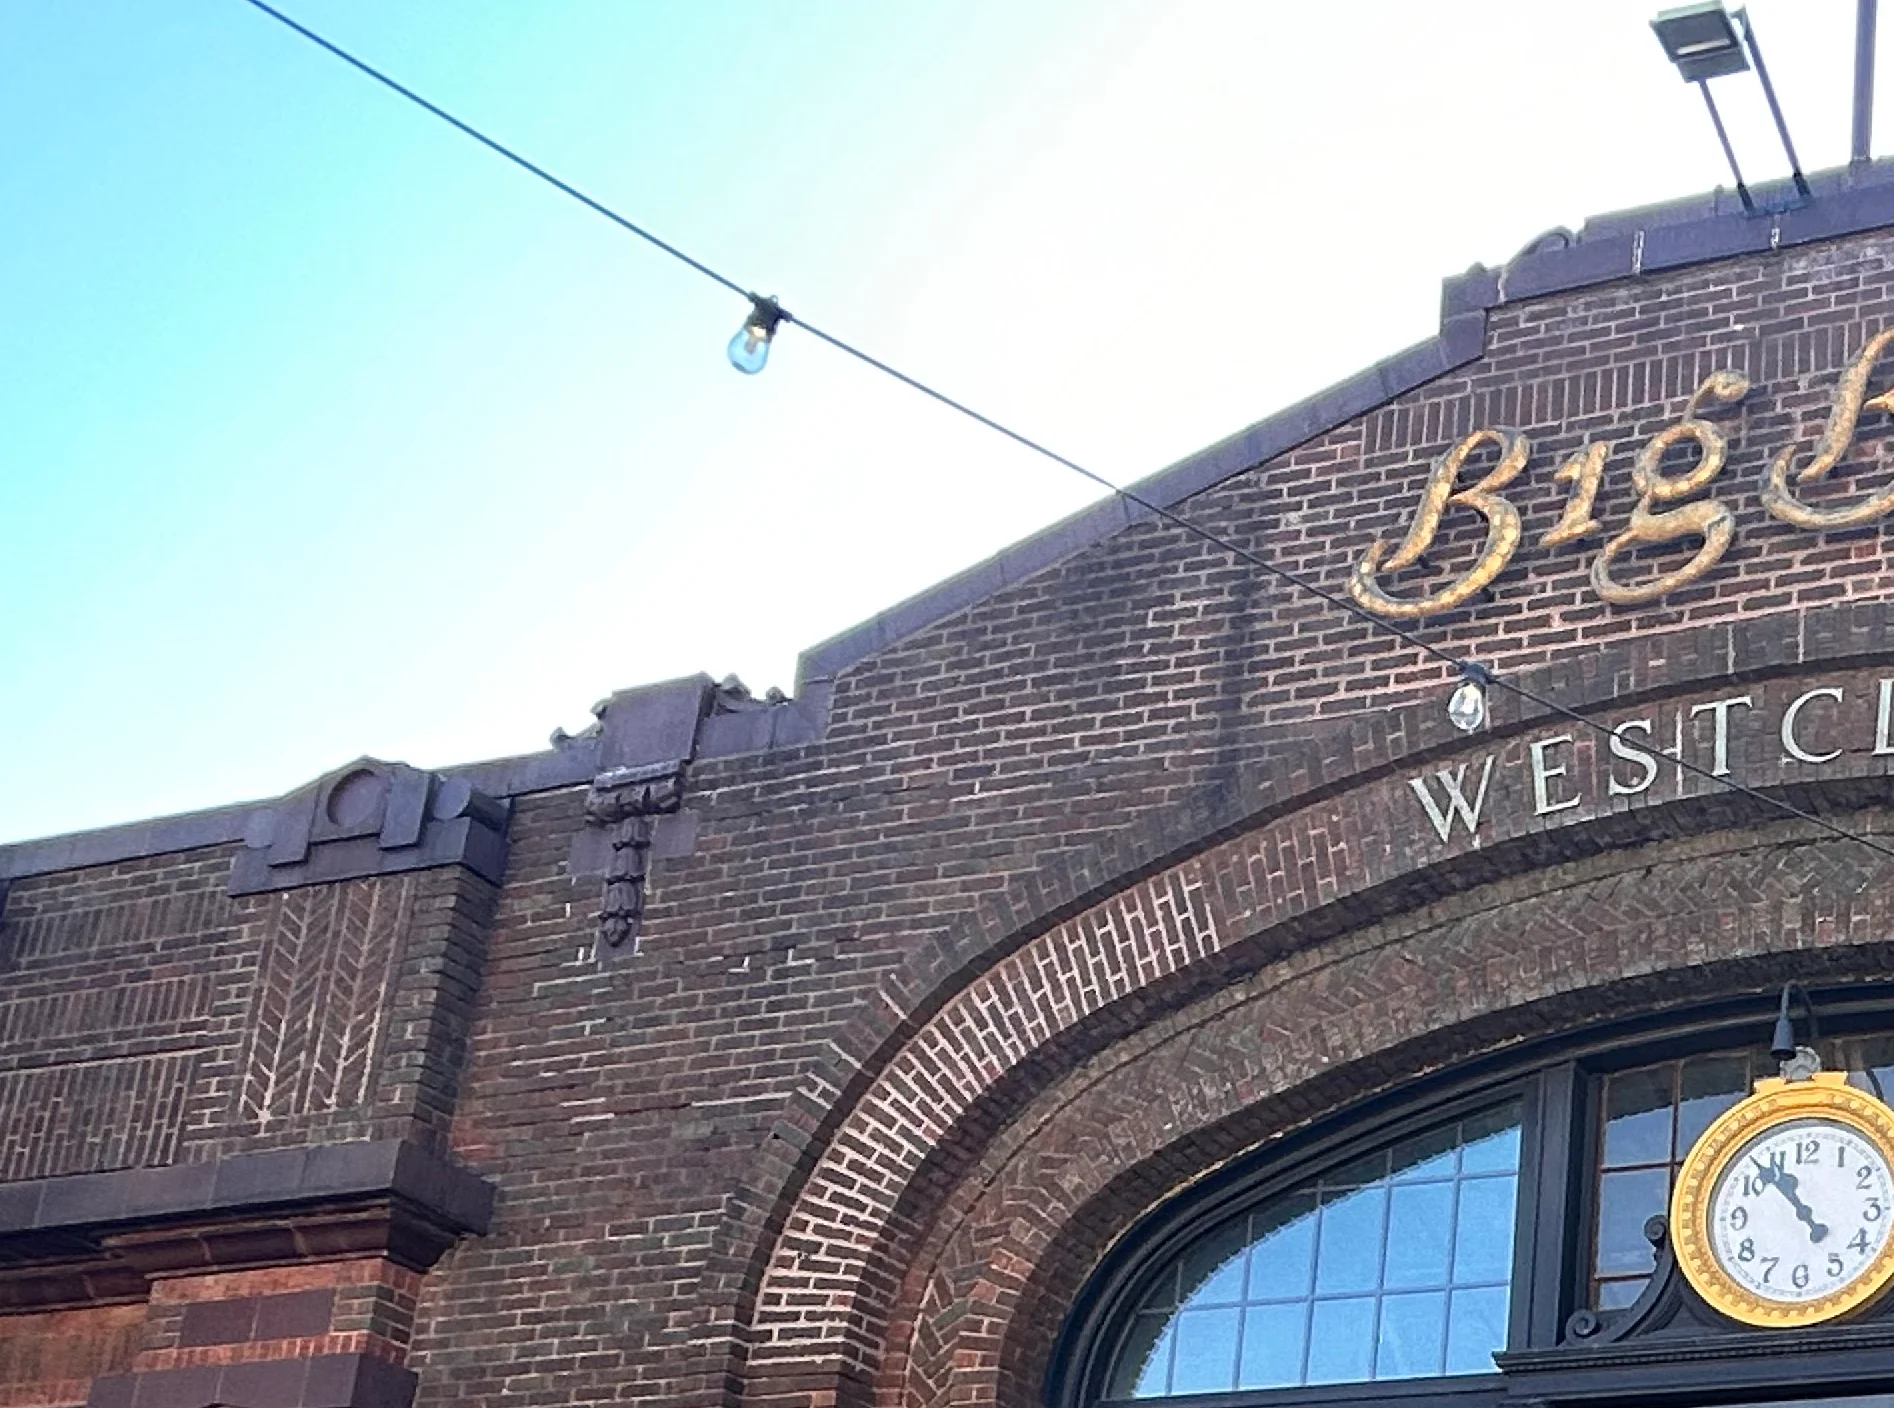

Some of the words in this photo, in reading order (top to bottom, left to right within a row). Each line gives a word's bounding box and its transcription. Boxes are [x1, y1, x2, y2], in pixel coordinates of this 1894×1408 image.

[1348, 369, 1750, 617] Big
[1796, 1140, 1820, 1164] 12
[1837, 1146, 1845, 1168] 1
[1743, 1174, 1766, 1197] 10
[1857, 1165, 1872, 1189] 2
[1730, 1206, 1748, 1230] 9
[1863, 1197, 1881, 1221] 3
[1738, 1238, 1755, 1262] 8
[1846, 1228, 1870, 1255] 4
[1760, 1257, 1779, 1284] 7
[1792, 1264, 1809, 1288] 6
[1826, 1253, 1844, 1277] 5
